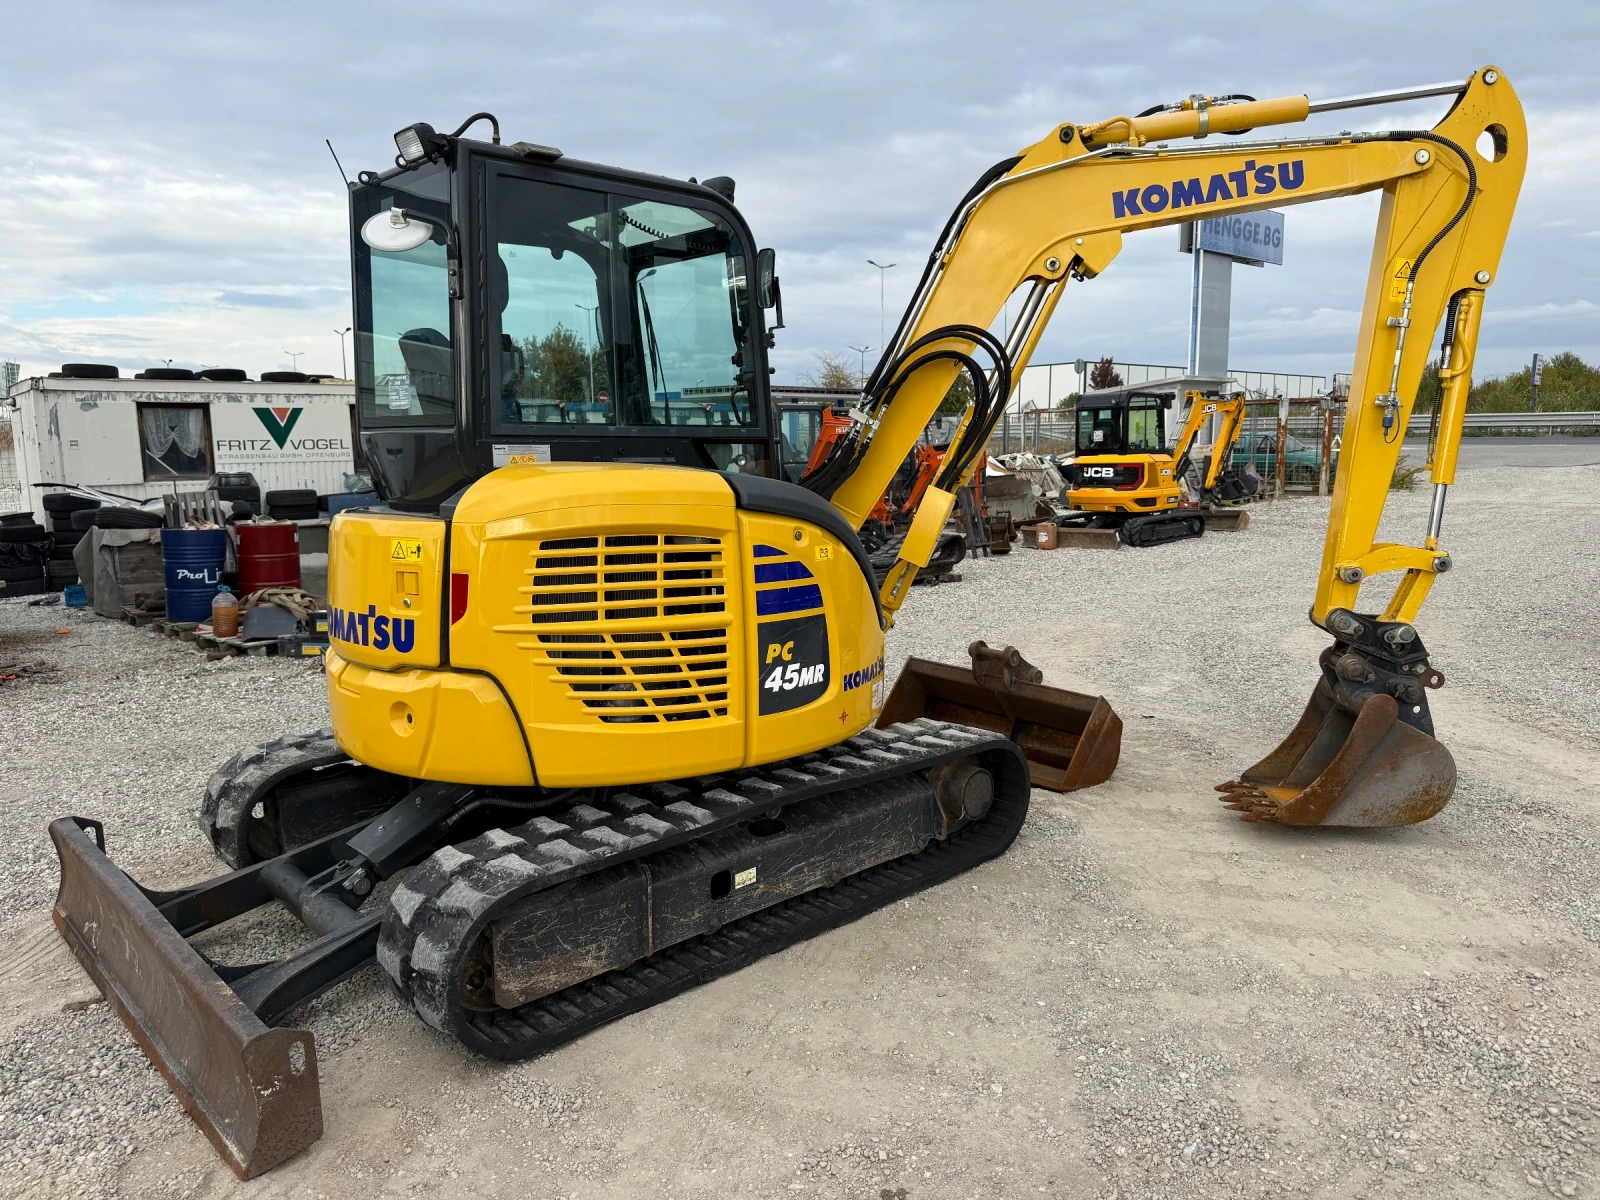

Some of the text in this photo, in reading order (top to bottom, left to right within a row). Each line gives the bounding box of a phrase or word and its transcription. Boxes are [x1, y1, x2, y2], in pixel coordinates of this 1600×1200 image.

[1112, 159, 1305, 219] KOMATSU
[1203, 215, 1281, 248] HENGGE.BG
[1202, 403, 1217, 414] JCB
[216, 438, 350, 451] FRITZ VOGEL
[217, 452, 278, 460] STRASSENBAU
[1083, 467, 1114, 477] JCB
[327, 604, 415, 653] OMATSU
[765, 640, 795, 664] PC
[764, 662, 825, 693] 45MR
